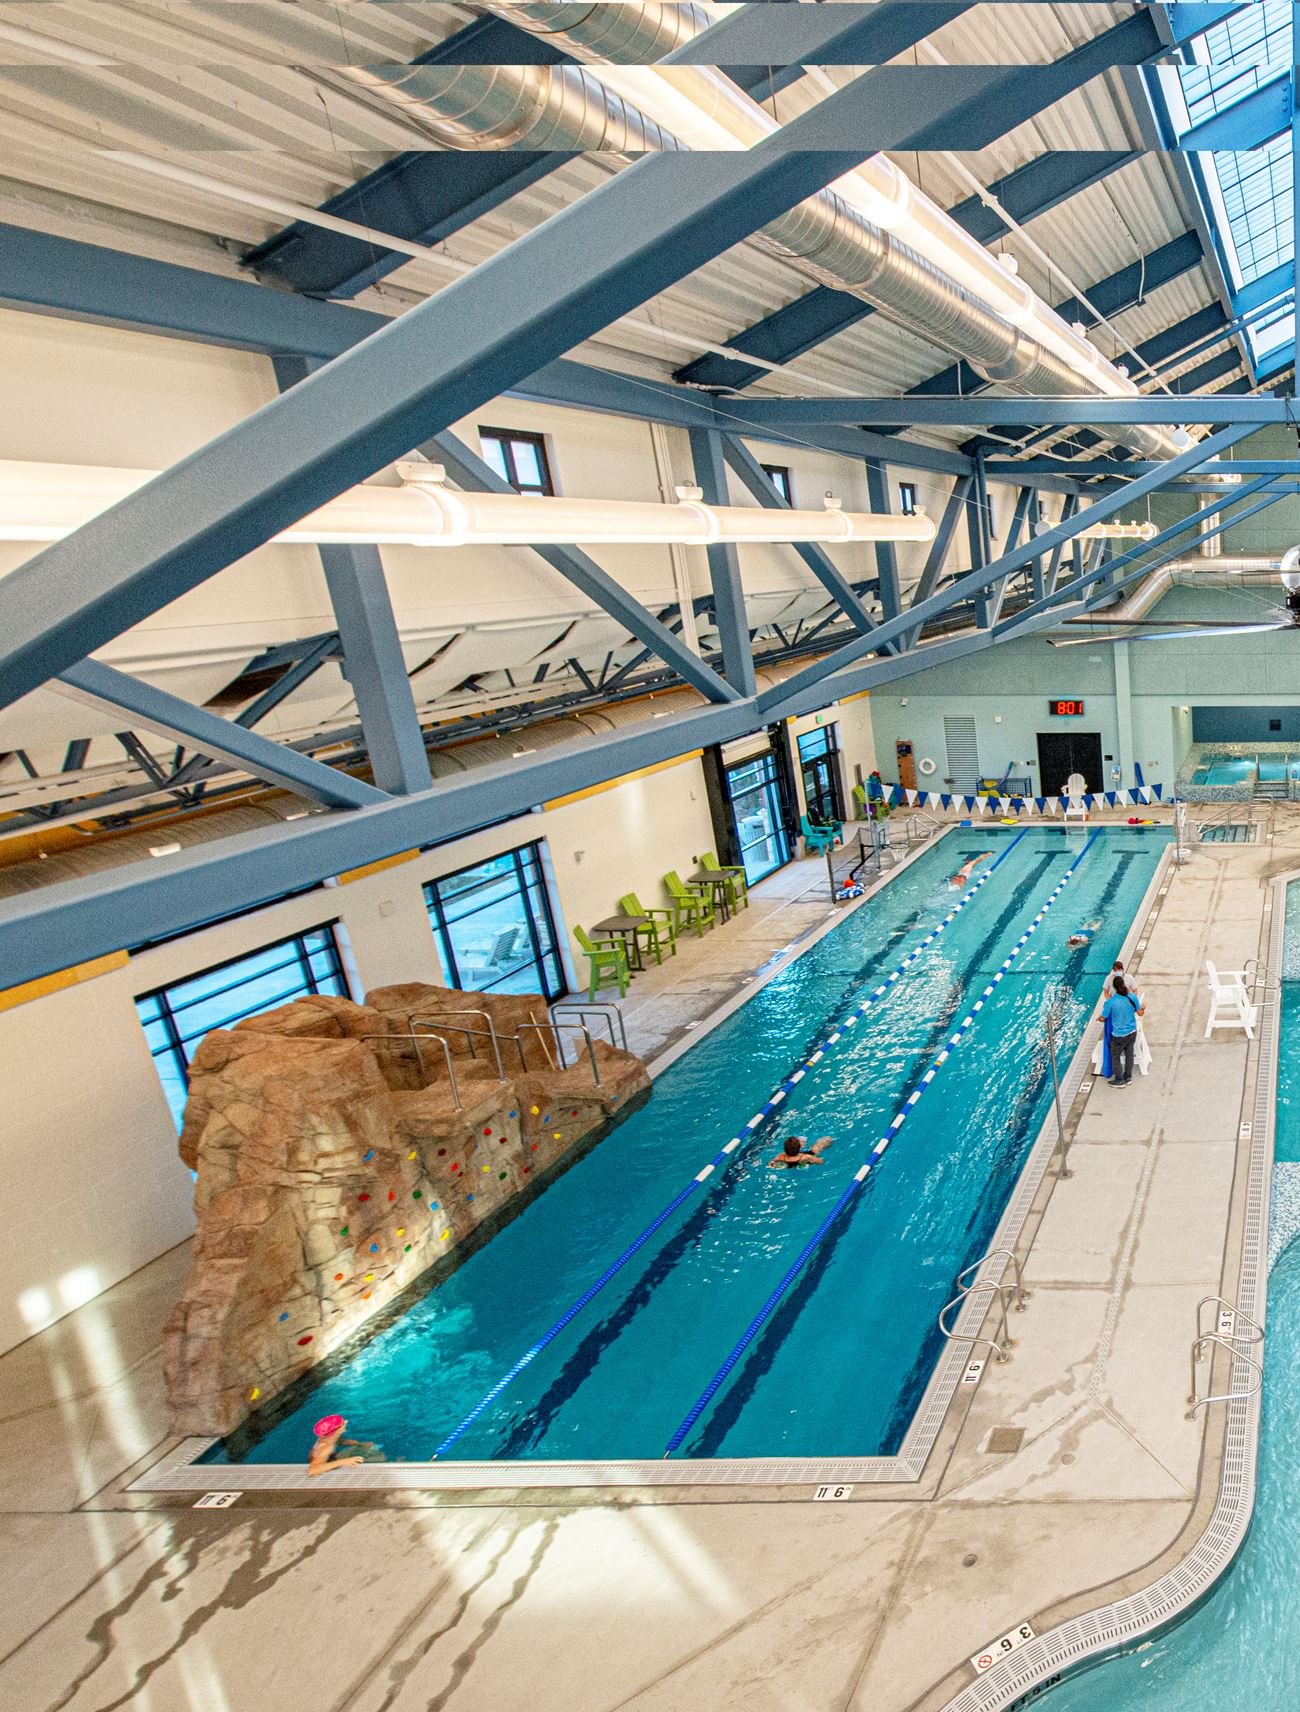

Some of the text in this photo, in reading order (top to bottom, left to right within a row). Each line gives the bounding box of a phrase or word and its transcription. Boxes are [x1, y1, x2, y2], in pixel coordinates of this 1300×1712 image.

[817, 1486, 845, 1498] 11 6
[216, 1494, 231, 1506] 6
[1019, 1626, 1031, 1639] 3
[1000, 1638, 1013, 1652] 6
